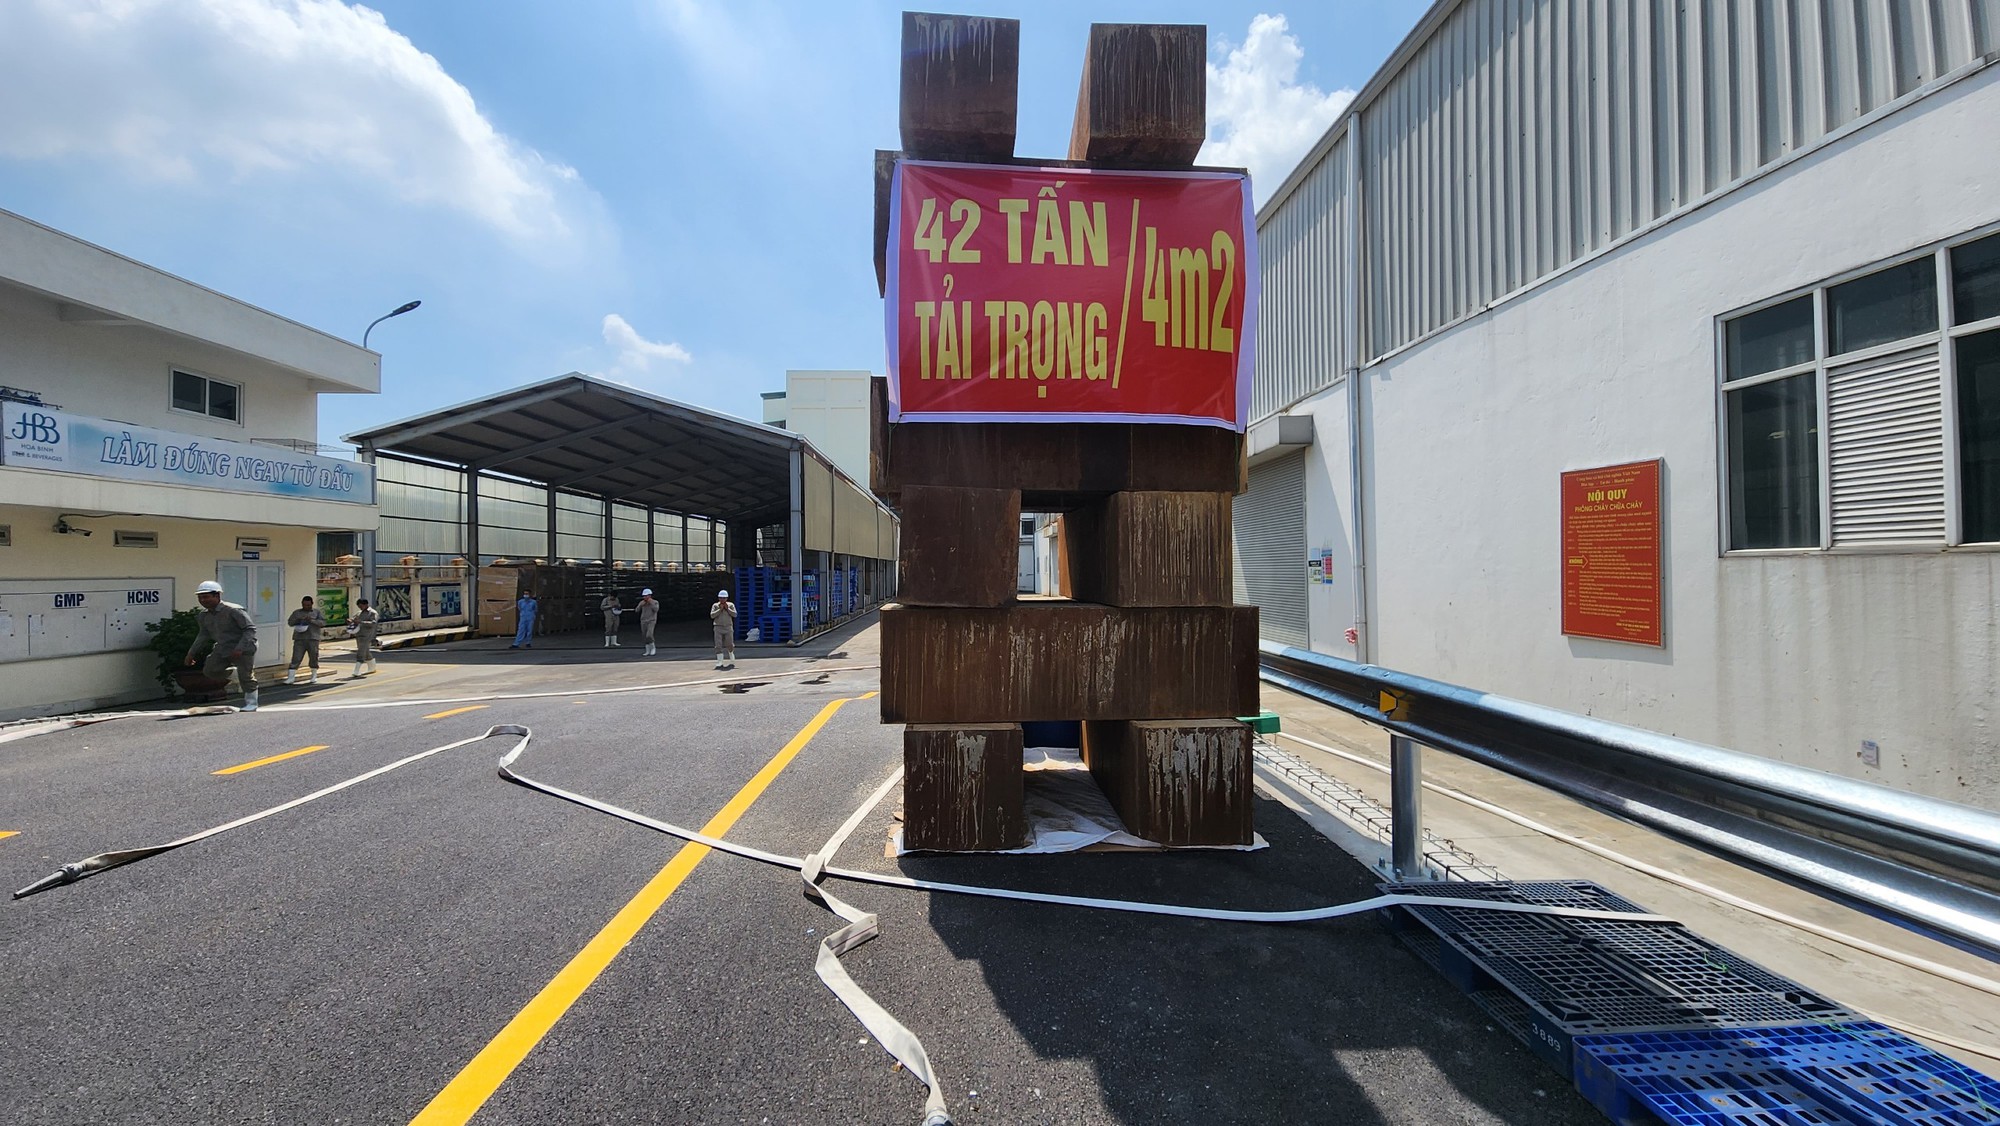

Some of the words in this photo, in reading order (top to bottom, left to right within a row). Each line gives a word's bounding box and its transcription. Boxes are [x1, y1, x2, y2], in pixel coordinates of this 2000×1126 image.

[914, 198, 981, 263] 42
[999, 180, 1109, 267] TẤN
[914, 274, 972, 380] TẢI
[984, 300, 1108, 398] TRỌNG
[101, 431, 157, 468] LÀM
[163, 442, 231, 477] ĐÚNG
[234, 456, 289, 483] NGAY
[291, 460, 317, 487] TỪ
[319, 464, 353, 492] ĐẦU
[1588, 489, 1605, 504] NỘI
[1607, 488, 1628, 501] QUY
[54, 593, 85, 608] GMP
[127, 591, 159, 604] HCNS
[1531, 1022, 1561, 1052] 3889
